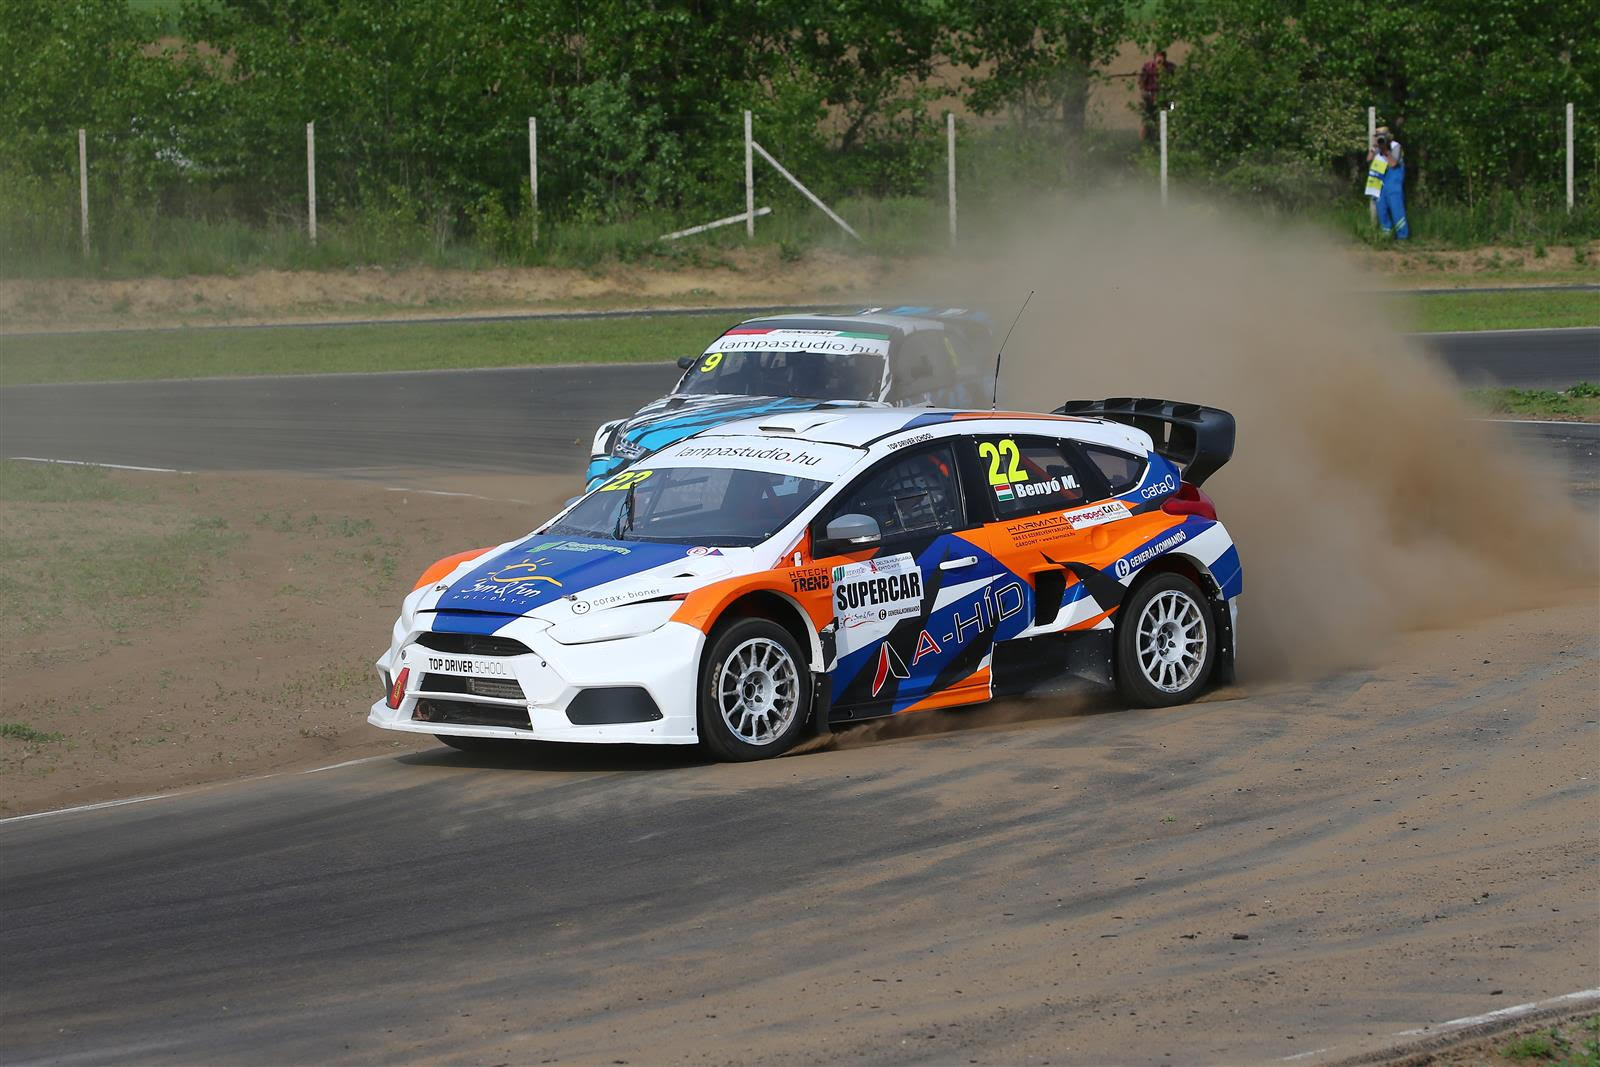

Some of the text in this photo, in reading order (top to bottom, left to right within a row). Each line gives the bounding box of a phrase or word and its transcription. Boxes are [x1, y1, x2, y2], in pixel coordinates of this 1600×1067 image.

[719, 337, 880, 353] lampastudio.hu
[701, 353, 723, 372] 9
[675, 445, 822, 467] lampastudio.hu
[979, 439, 1028, 485] 22
[600, 470, 653, 491] 22
[1015, 475, 1080, 498] Benyó M.
[1006, 516, 1068, 533] HARMATA
[789, 567, 828, 579] HETECH
[792, 575, 830, 593] TREND
[836, 572, 921, 611] SUPERCAR
[452, 595, 527, 605] HOLIDAYS
[593, 587, 661, 608] corax bioner
[912, 581, 1024, 666] A-HÍD
[429, 658, 506, 675] TOP DRIVER SCHOOL
